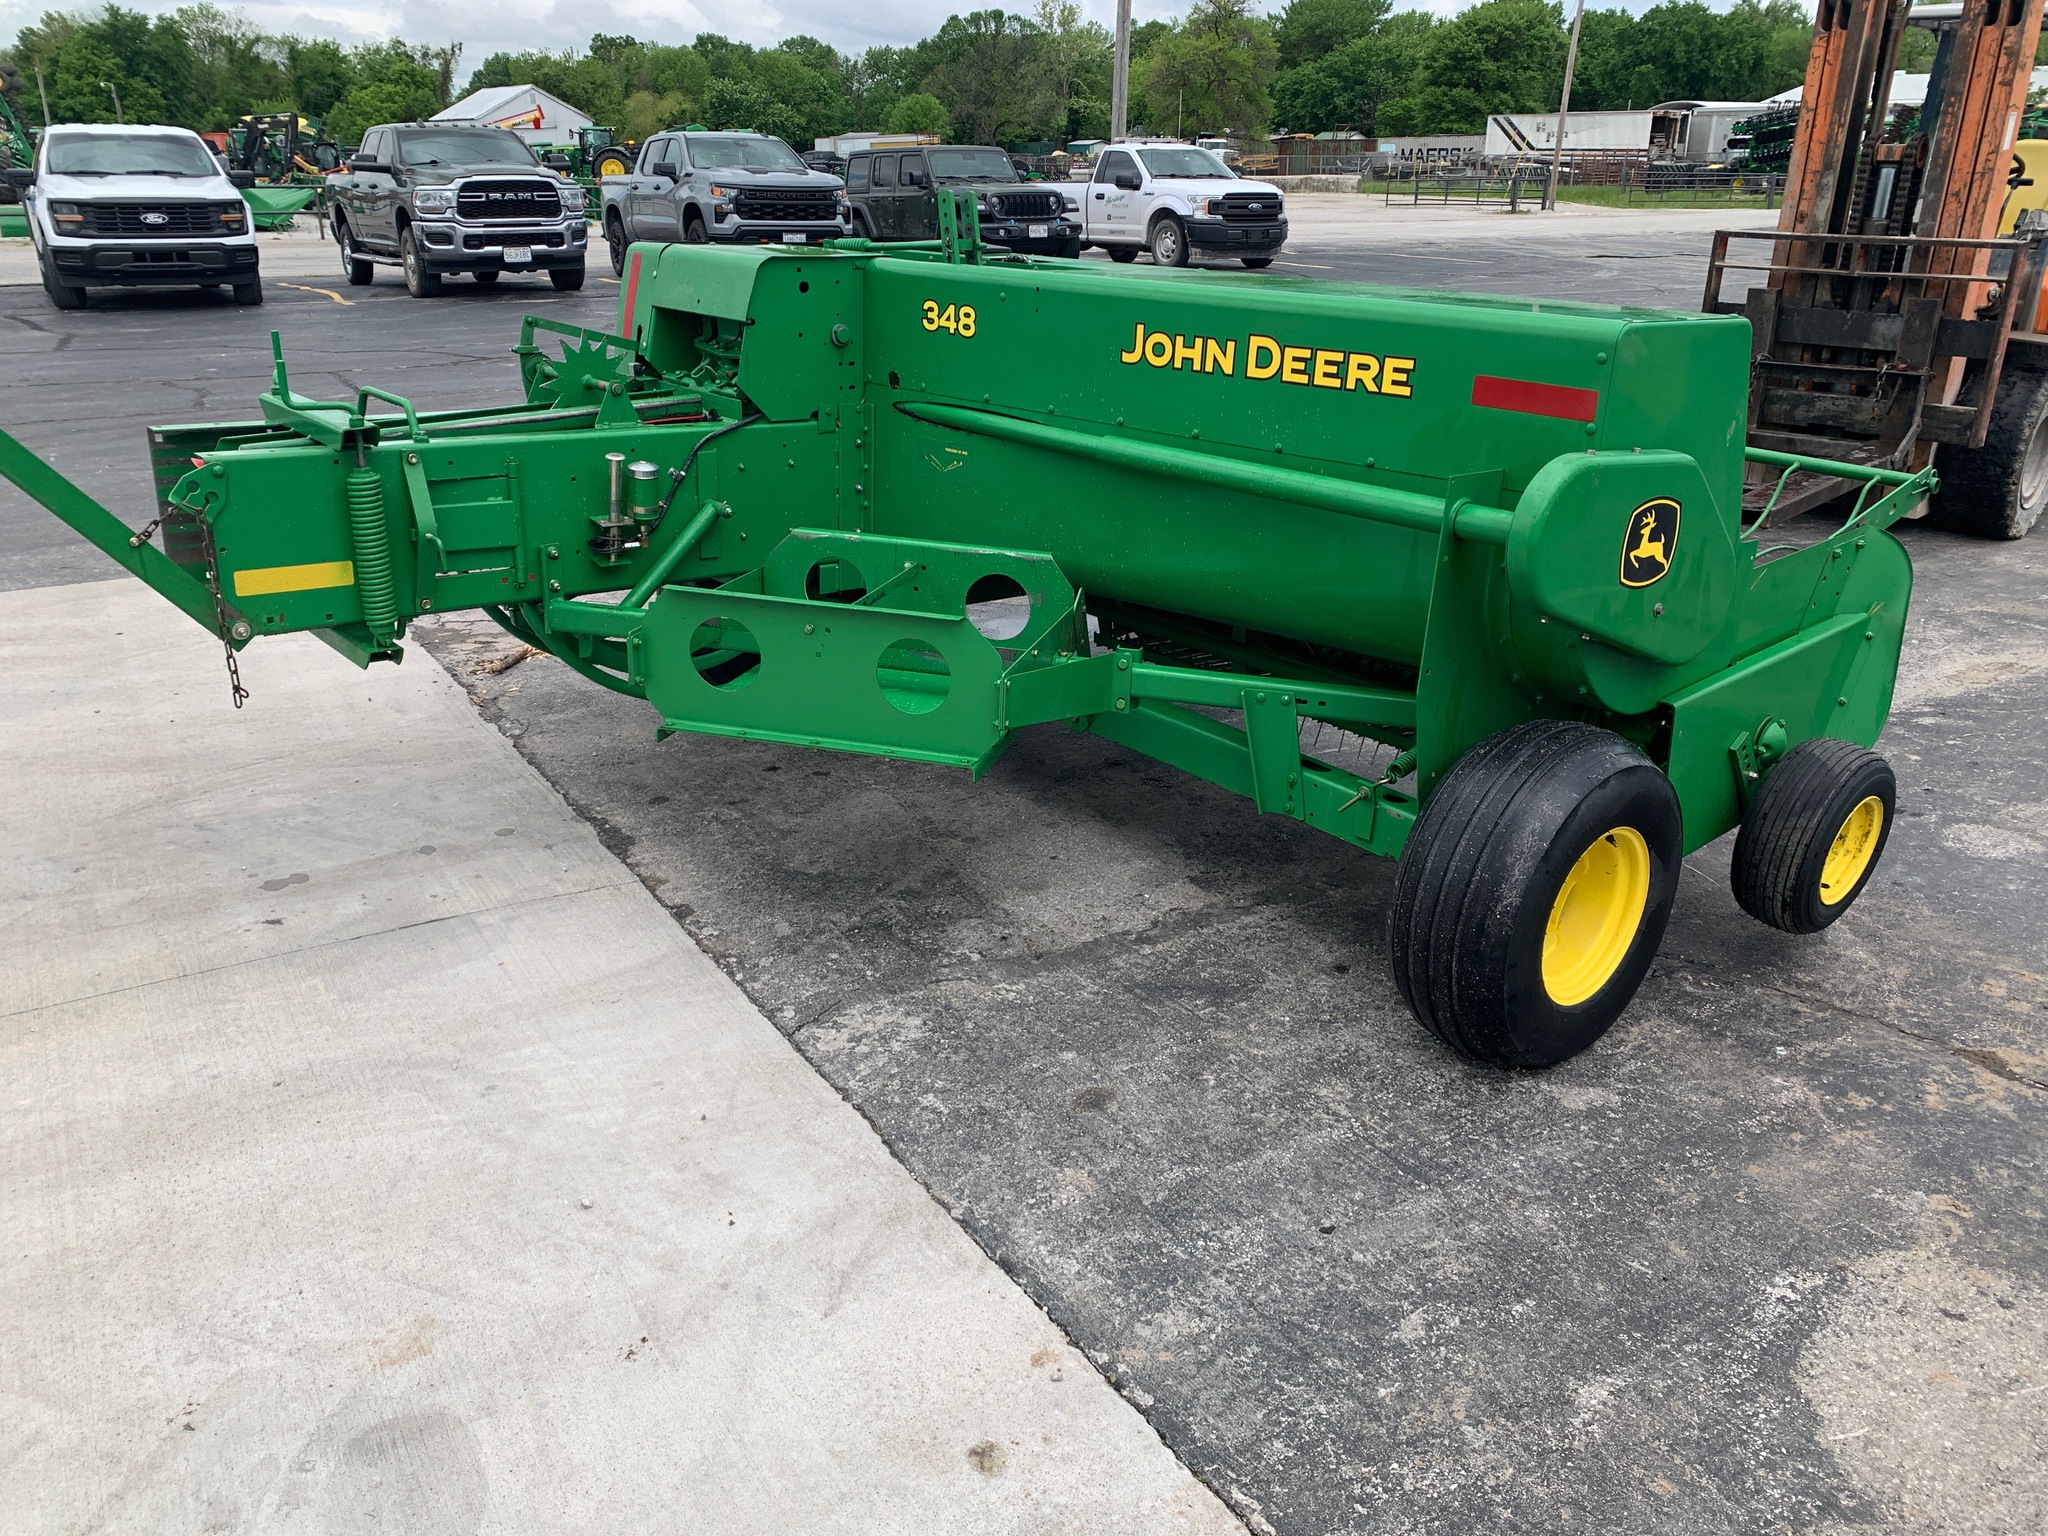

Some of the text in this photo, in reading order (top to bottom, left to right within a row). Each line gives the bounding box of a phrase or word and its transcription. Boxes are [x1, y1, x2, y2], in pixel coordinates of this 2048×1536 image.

[746, 191, 830, 200] CHEVROLET
[921, 299, 977, 338] 348
[1121, 321, 1416, 399] JOHN DEERE
